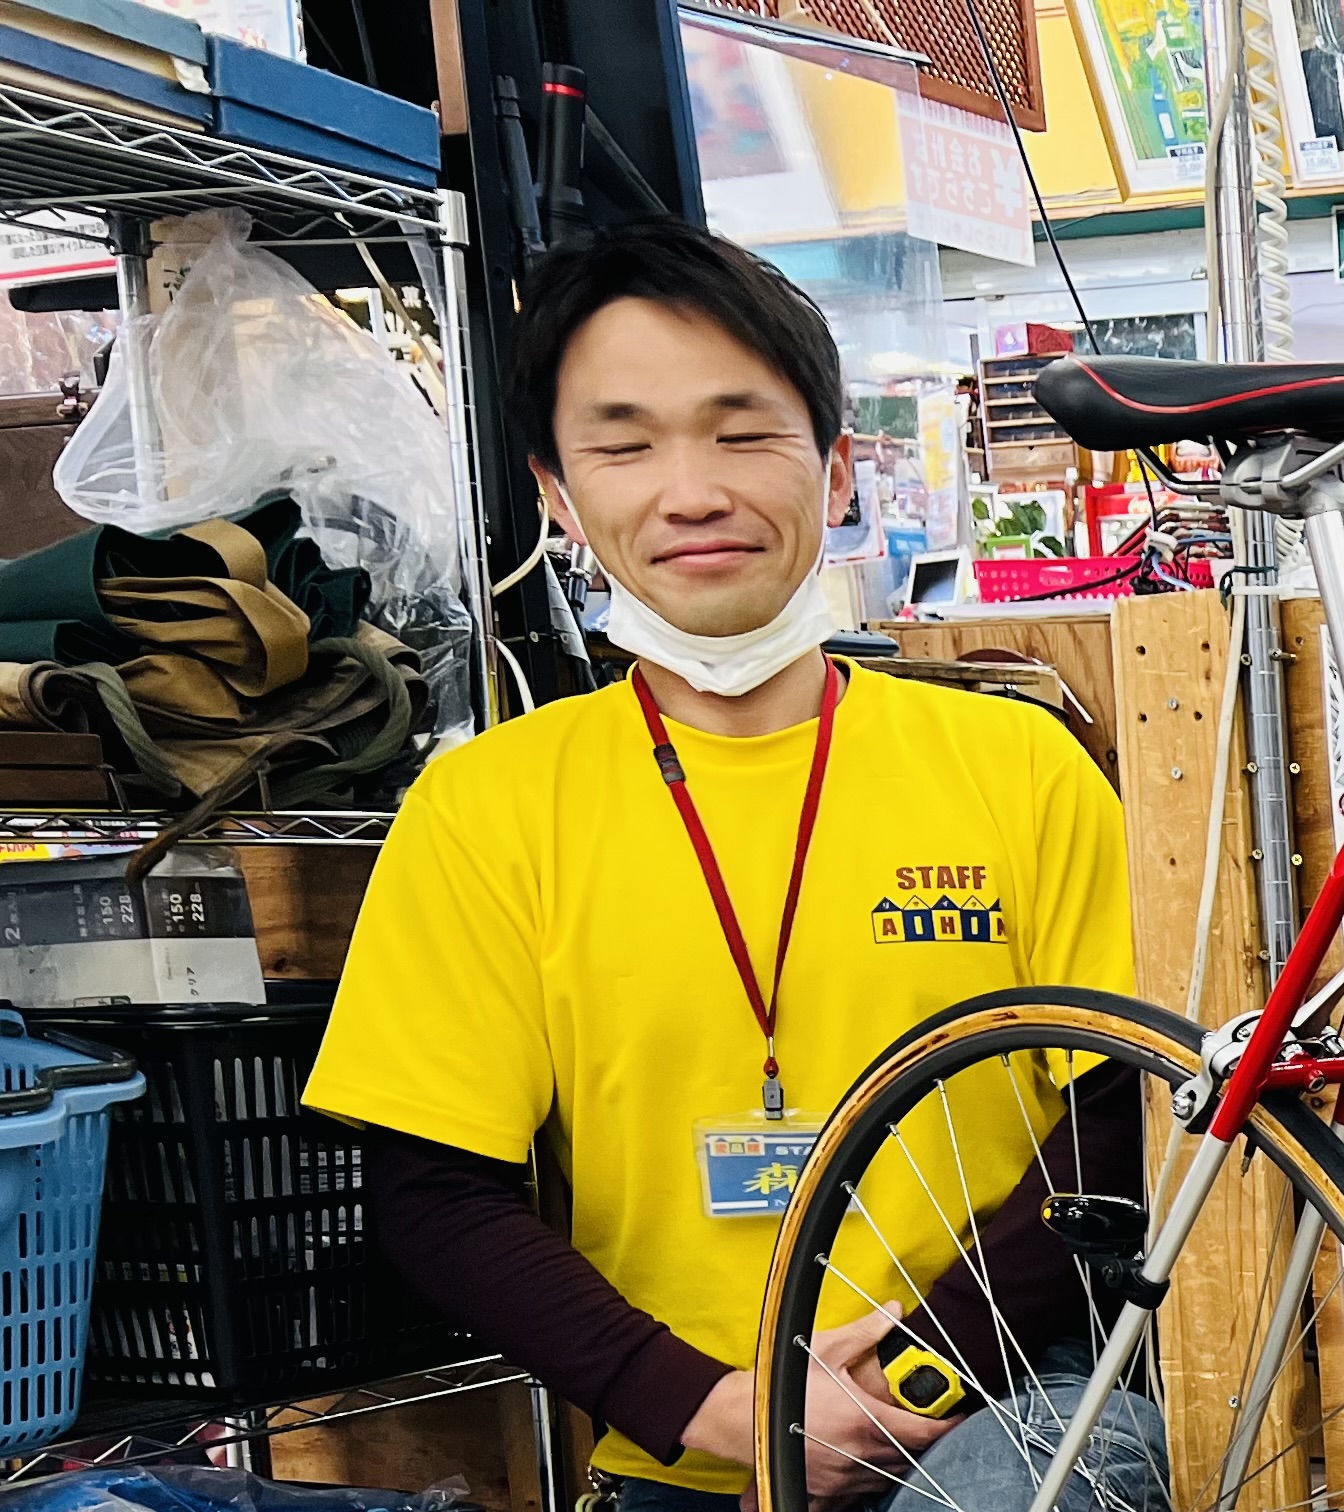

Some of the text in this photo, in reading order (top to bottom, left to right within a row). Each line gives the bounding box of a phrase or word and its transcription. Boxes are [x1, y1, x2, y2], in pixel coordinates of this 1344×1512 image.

[896, 866, 986, 890] STAFF
[99, 896, 113, 926] 150
[169, 893, 184, 923] 150
[190, 893, 206, 922] 228
